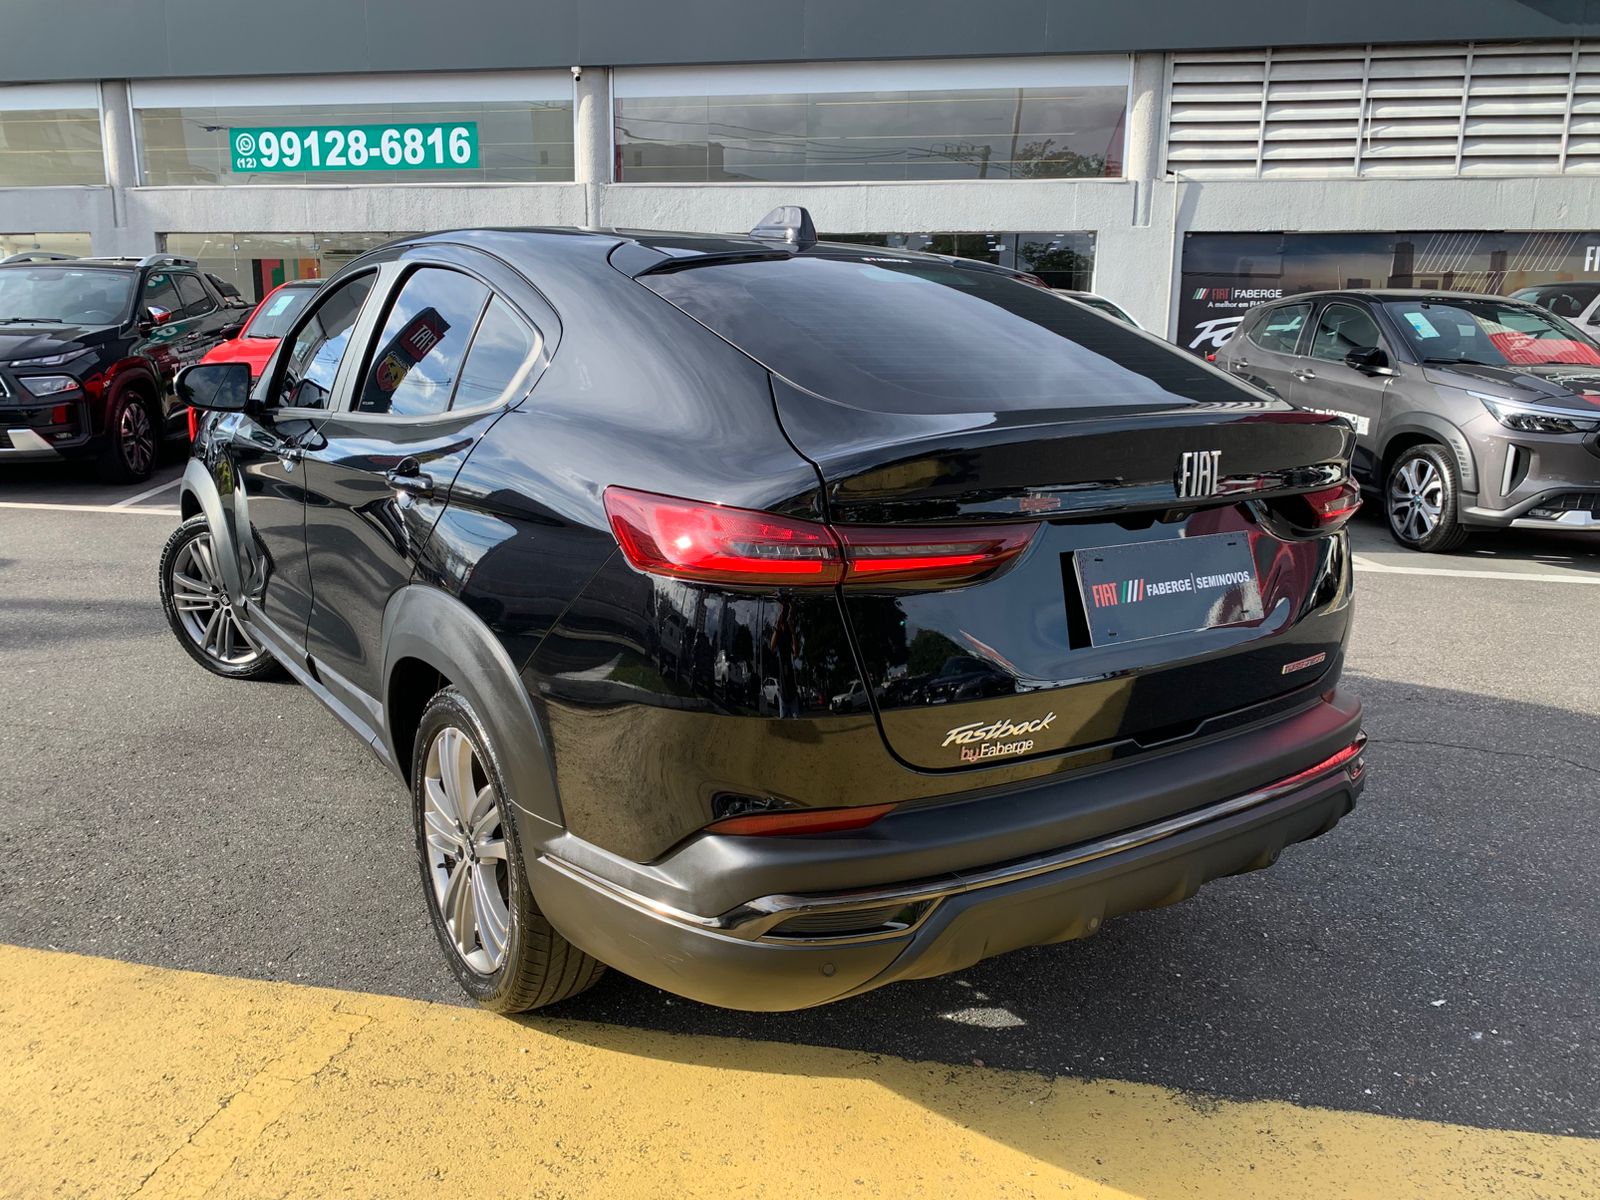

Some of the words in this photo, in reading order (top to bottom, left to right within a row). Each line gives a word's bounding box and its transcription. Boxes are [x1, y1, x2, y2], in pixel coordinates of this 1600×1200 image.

[237, 157, 257, 169] (12)
[258, 127, 471, 167] 99128-6816
[1212, 288, 1230, 301] FIAT
[1234, 289, 1282, 299] FABERGE
[1179, 450, 1222, 498] FIAT
[1092, 582, 1118, 608] FIAT
[1146, 578, 1192, 597] FABERGE
[1196, 570, 1250, 589] SEMINOVOS
[941, 711, 1057, 747] Fastback
